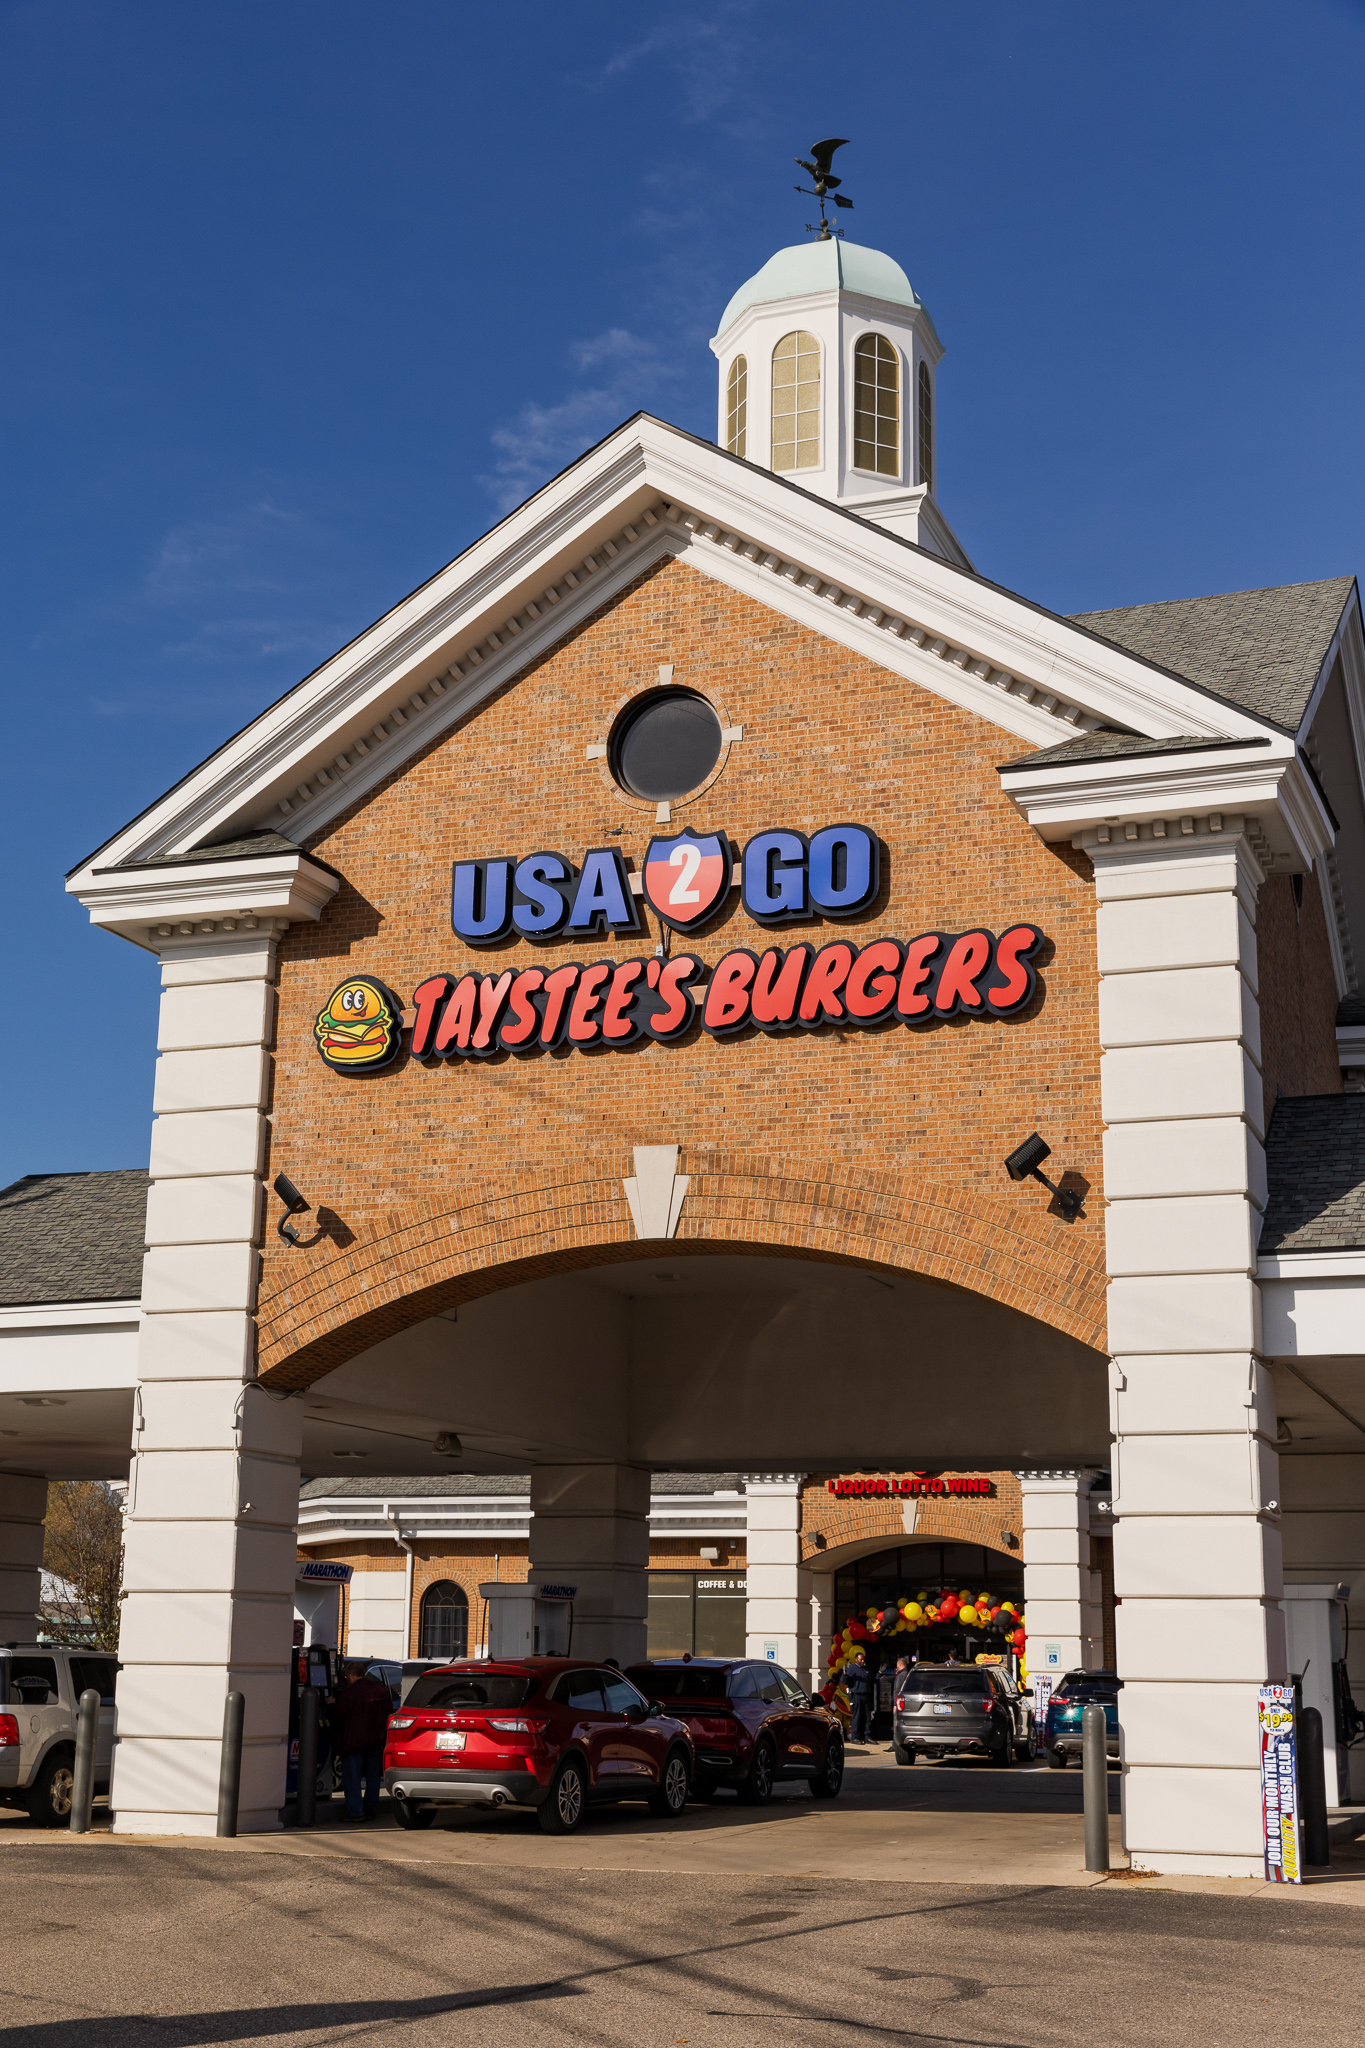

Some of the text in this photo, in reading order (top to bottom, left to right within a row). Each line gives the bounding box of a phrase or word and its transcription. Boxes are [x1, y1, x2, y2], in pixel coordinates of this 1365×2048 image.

[453, 826, 872, 937] USA 2 GO
[411, 927, 1036, 1054] TAYSTEE'S BURGERS
[828, 1478, 990, 1494] LIQUOR LOTTO WINE
[303, 1563, 350, 1579] MARATHON
[541, 1584, 578, 1598] MARATHON
[697, 1580, 727, 1589] COFFEE
[729, 1580, 735, 1589] &
[1259, 1688, 1293, 1698] USA 2 GO
[1258, 1712, 1294, 1728] $19.99
[1263, 1750, 1282, 1867] JOIN OUR MONTHLY
[1277, 1742, 1298, 1878] QUALITY WASH CLUB
